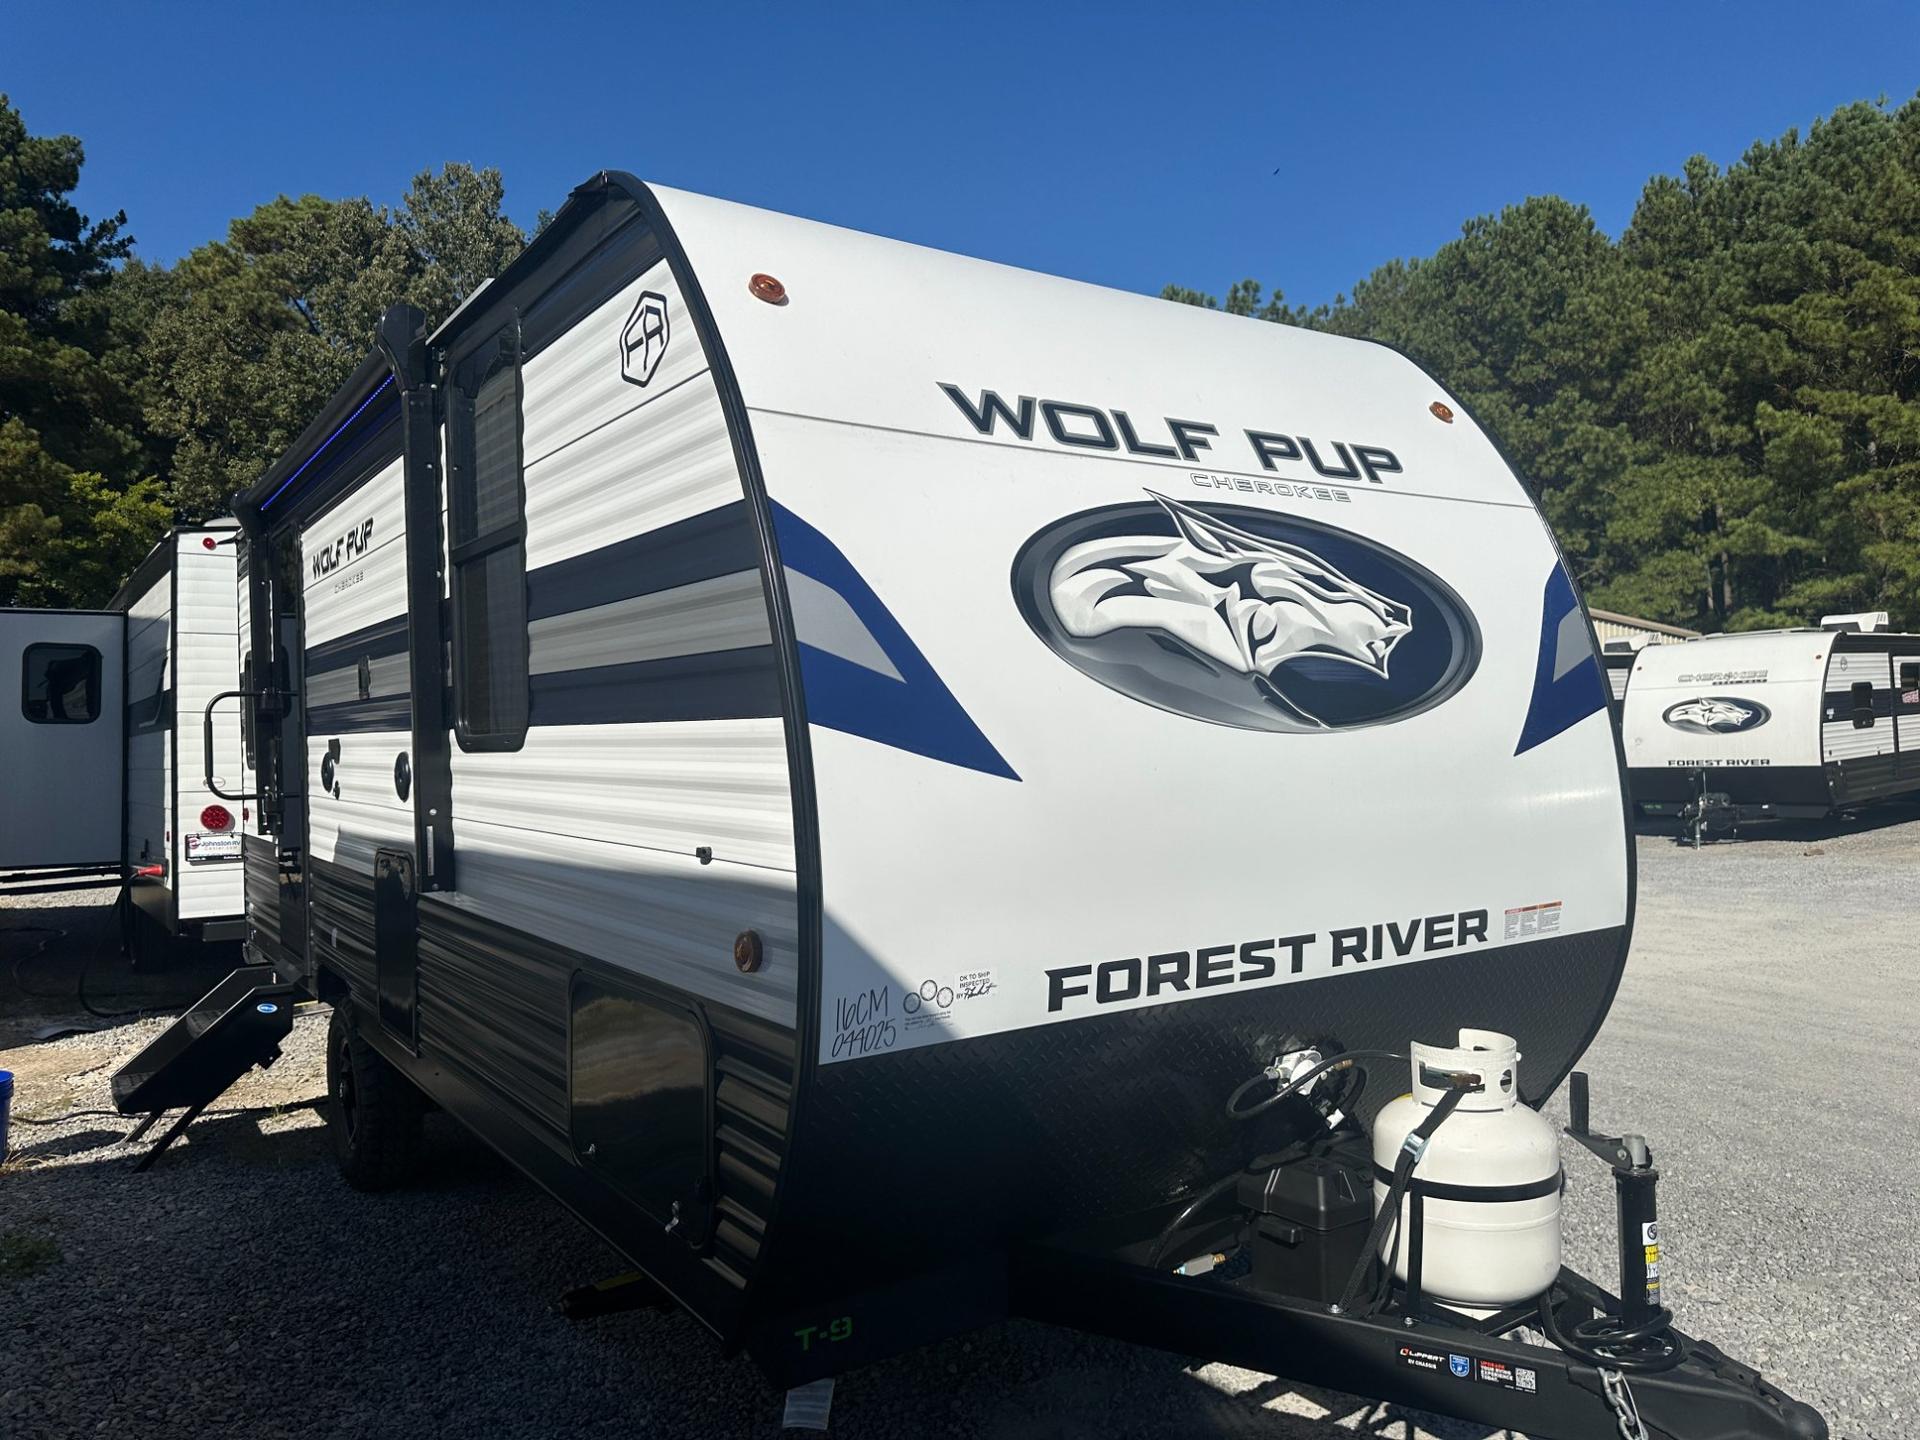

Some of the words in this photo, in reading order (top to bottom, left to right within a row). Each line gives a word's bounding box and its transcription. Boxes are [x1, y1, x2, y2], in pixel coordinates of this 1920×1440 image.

[936, 382, 1219, 462] WOLF
[1243, 429, 1404, 484] PUP
[1190, 473, 1352, 503] CHEROKEE
[313, 537, 344, 579] WOLF
[346, 517, 373, 561] PUP
[1045, 933, 1316, 1012] FOREST
[1329, 908, 1488, 967] RIVER
[836, 985, 889, 1033] 16CM
[831, 1018, 897, 1058] 044025
